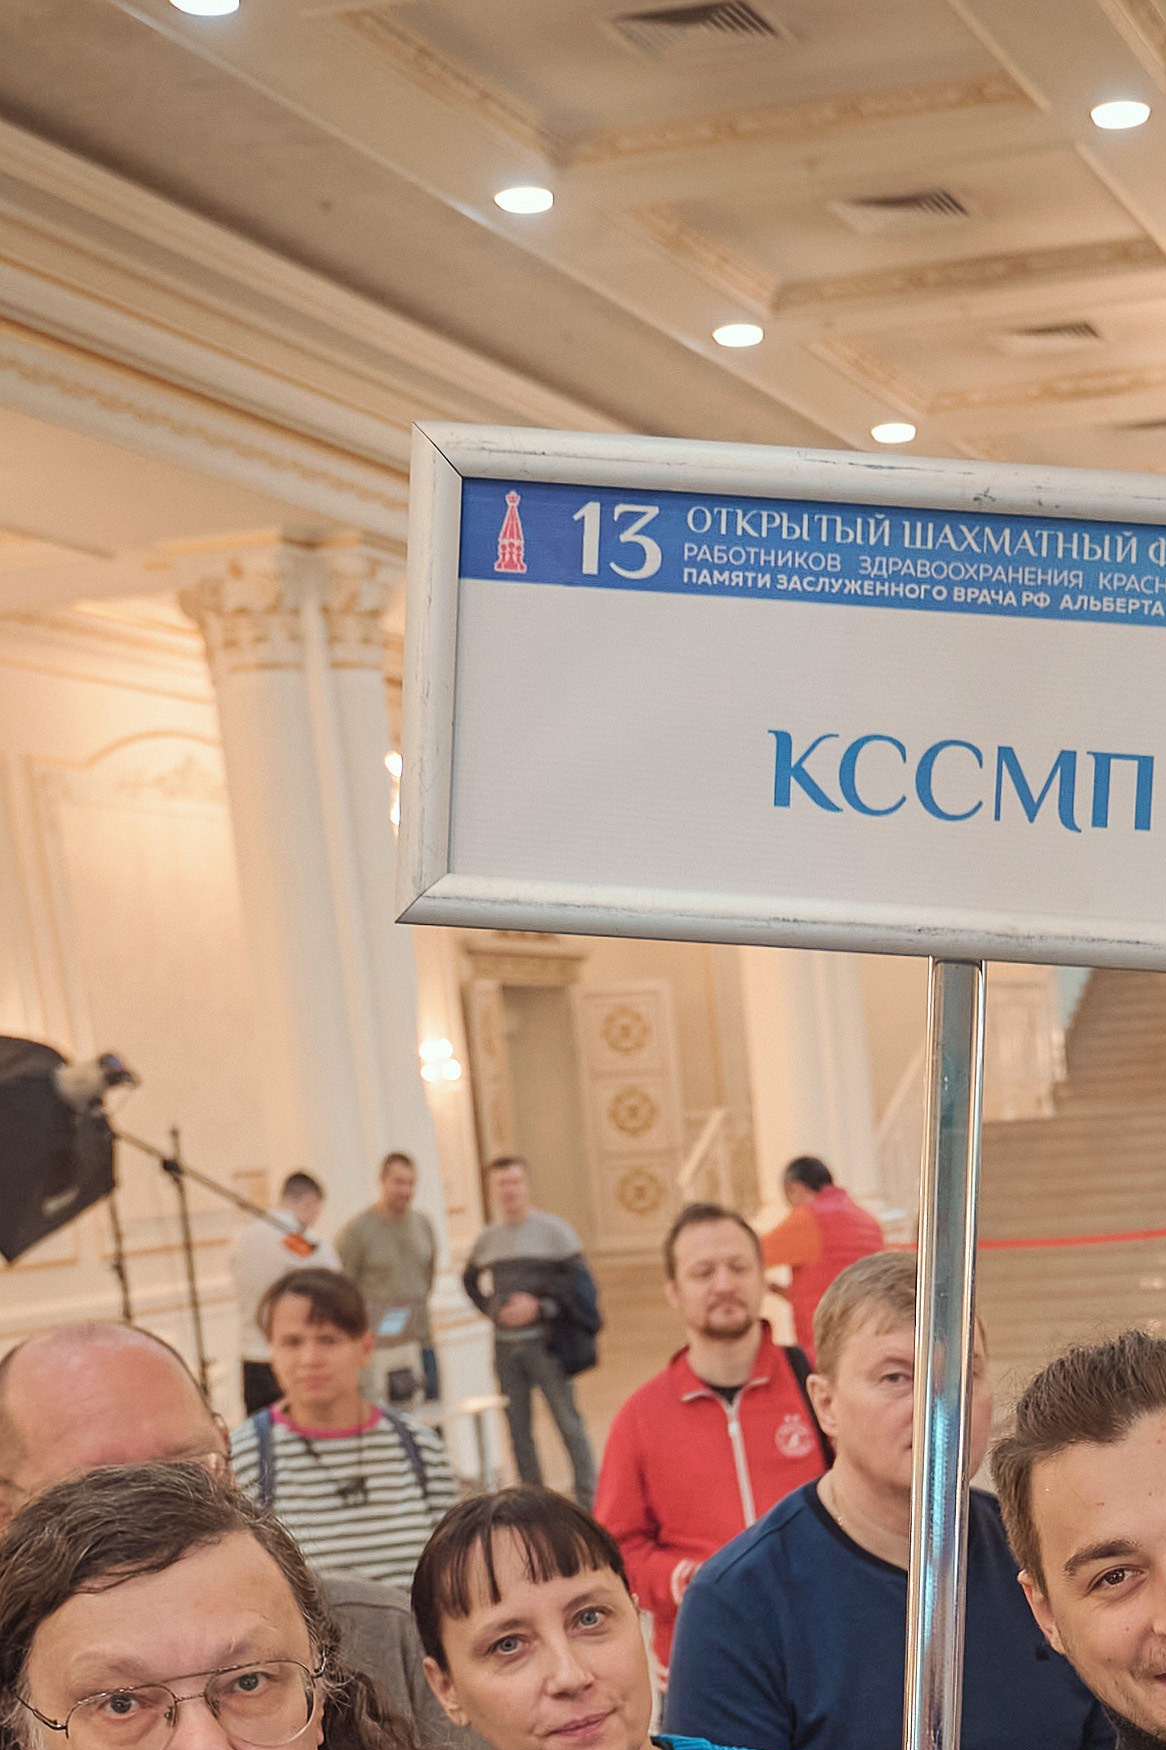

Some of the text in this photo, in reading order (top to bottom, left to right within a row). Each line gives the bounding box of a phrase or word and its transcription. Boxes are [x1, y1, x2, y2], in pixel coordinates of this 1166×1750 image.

[573, 501, 662, 580] 13
[687, 506, 890, 546] ОТКРЫТЫЙ
[902, 520, 1137, 564] ШАХМАТНЫЙ
[683, 543, 841, 572] РАБОТНИКОВ
[858, 556, 1083, 589] ЗДРАВООХРАНЕНИЯ
[683, 568, 771, 588] ПАМЯТИ
[776, 574, 948, 600] ЗАСЛУЖЕННОГО
[953, 587, 1016, 607] ВРАЧА
[1022, 591, 1050, 608] РФ
[1059, 594, 1165, 616] АЛЬБЕРТА
[768, 730, 1154, 833] КССМП
